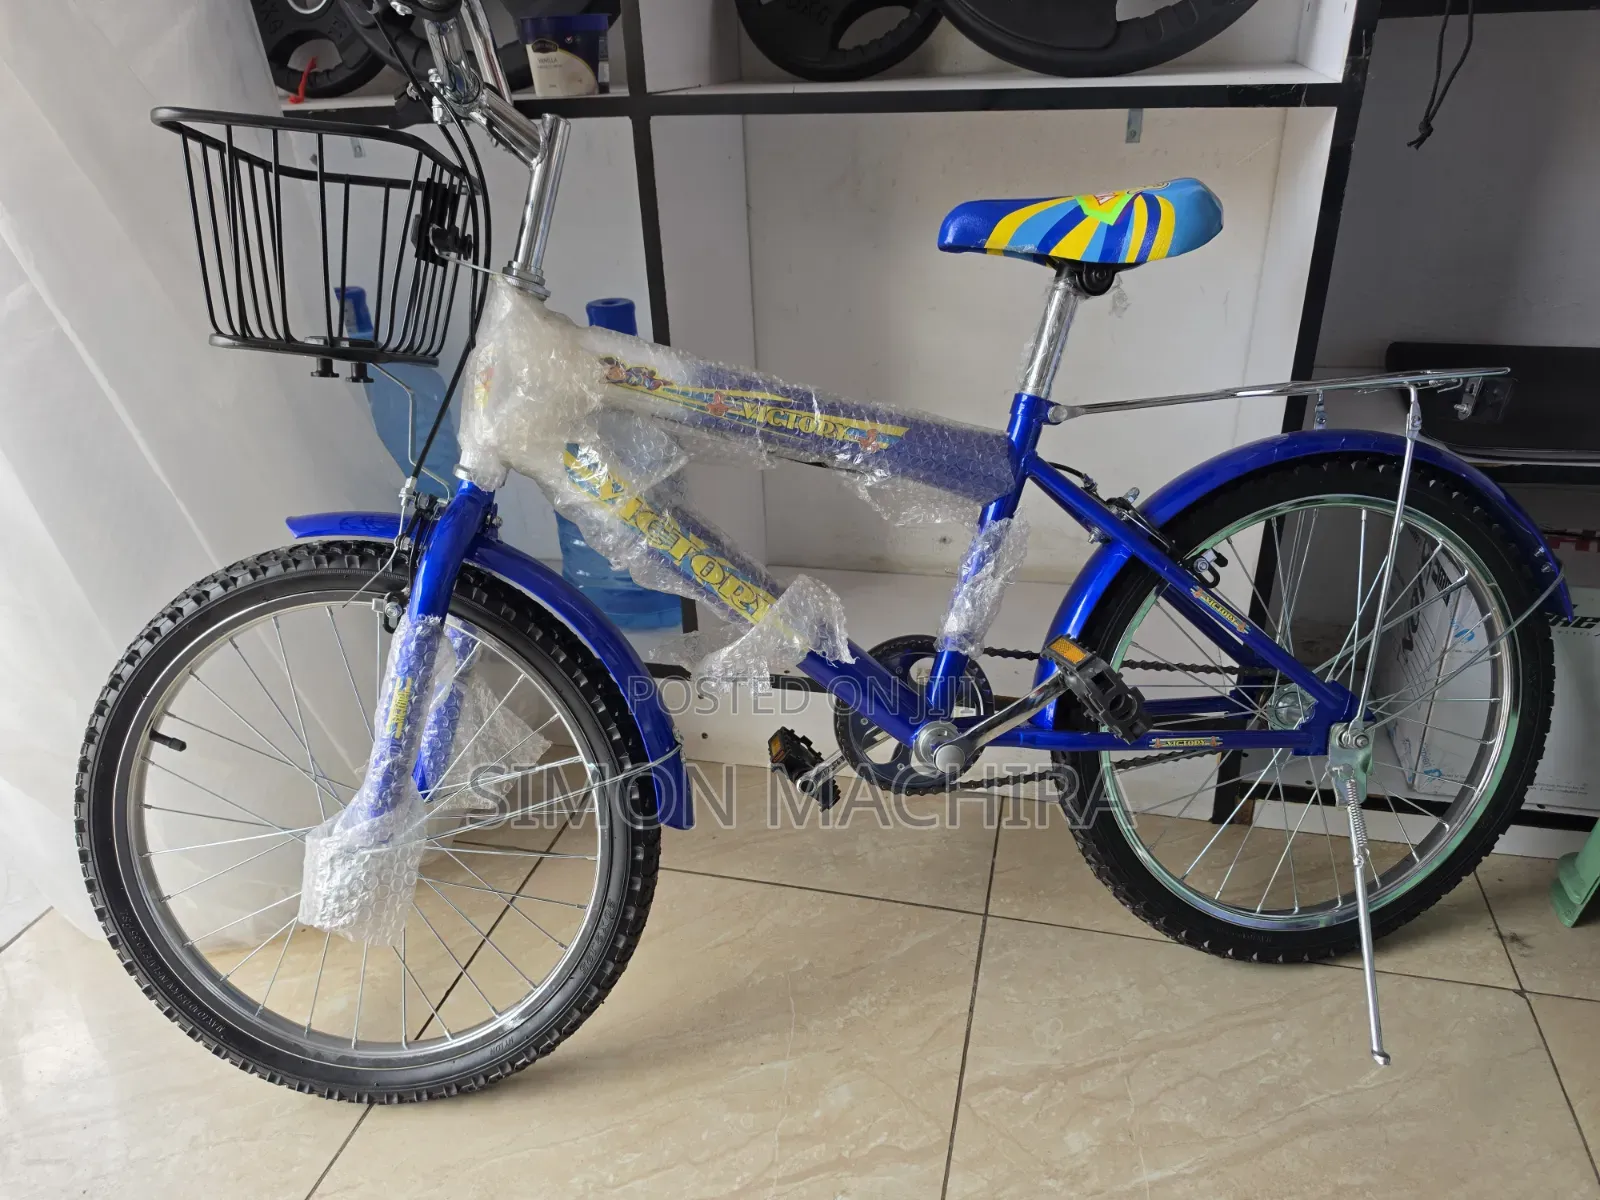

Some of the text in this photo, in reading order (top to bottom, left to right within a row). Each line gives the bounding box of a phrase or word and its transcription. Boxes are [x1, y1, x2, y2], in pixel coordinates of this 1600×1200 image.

[742, 401, 849, 440] VICTORY
[1203, 597, 1239, 624] VICTORY
[1166, 738, 1206, 747] VICTORY
[489, 1035, 515, 1056] NYLON
